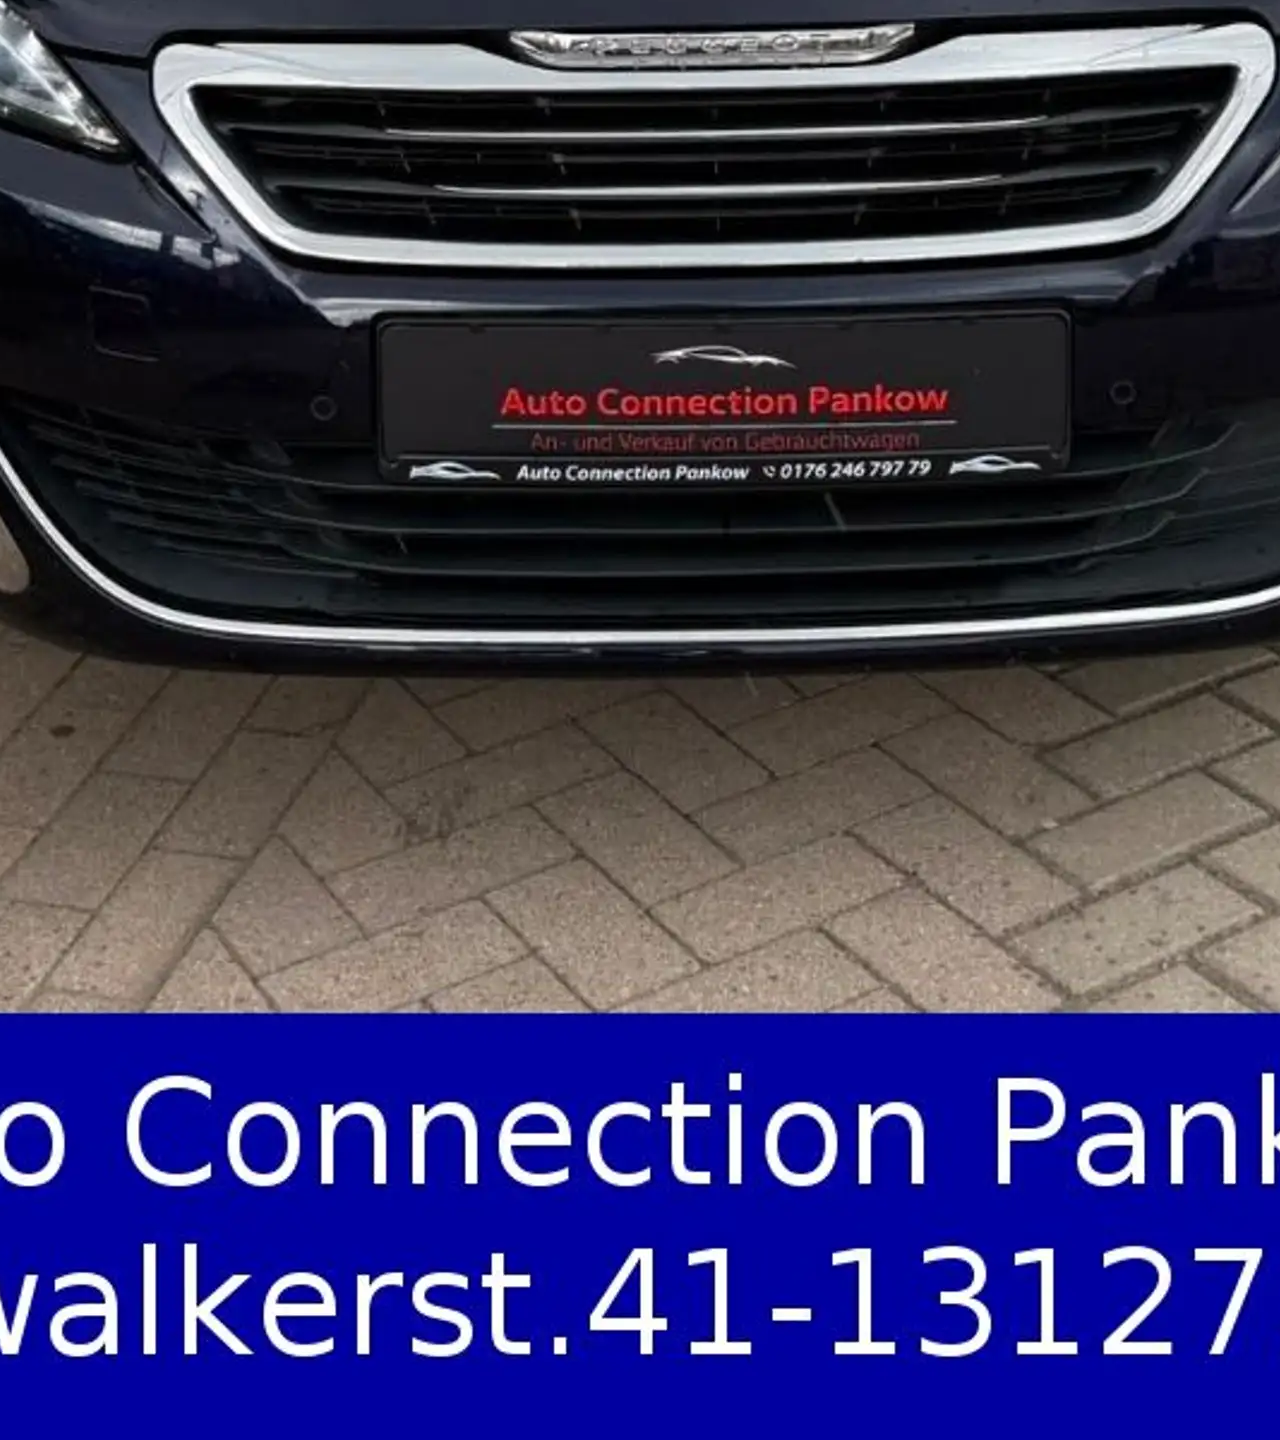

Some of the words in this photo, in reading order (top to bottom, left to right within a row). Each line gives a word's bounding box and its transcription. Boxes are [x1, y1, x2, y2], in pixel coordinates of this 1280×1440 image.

[501, 386, 587, 416] Auto
[596, 385, 798, 416] Connection
[809, 383, 948, 415] Pankow
[574, 431, 613, 452] und
[619, 429, 695, 452] Verkauf
[700, 434, 738, 451] von
[745, 430, 921, 452] Gebrauchtwagen
[516, 463, 561, 481] Auto
[565, 463, 670, 482] Connection
[675, 463, 750, 481] Pankow
[780, 461, 827, 479] 0176
[828, 461, 865, 478] 246
[869, 460, 905, 477] 797
[908, 459, 933, 477] 79
